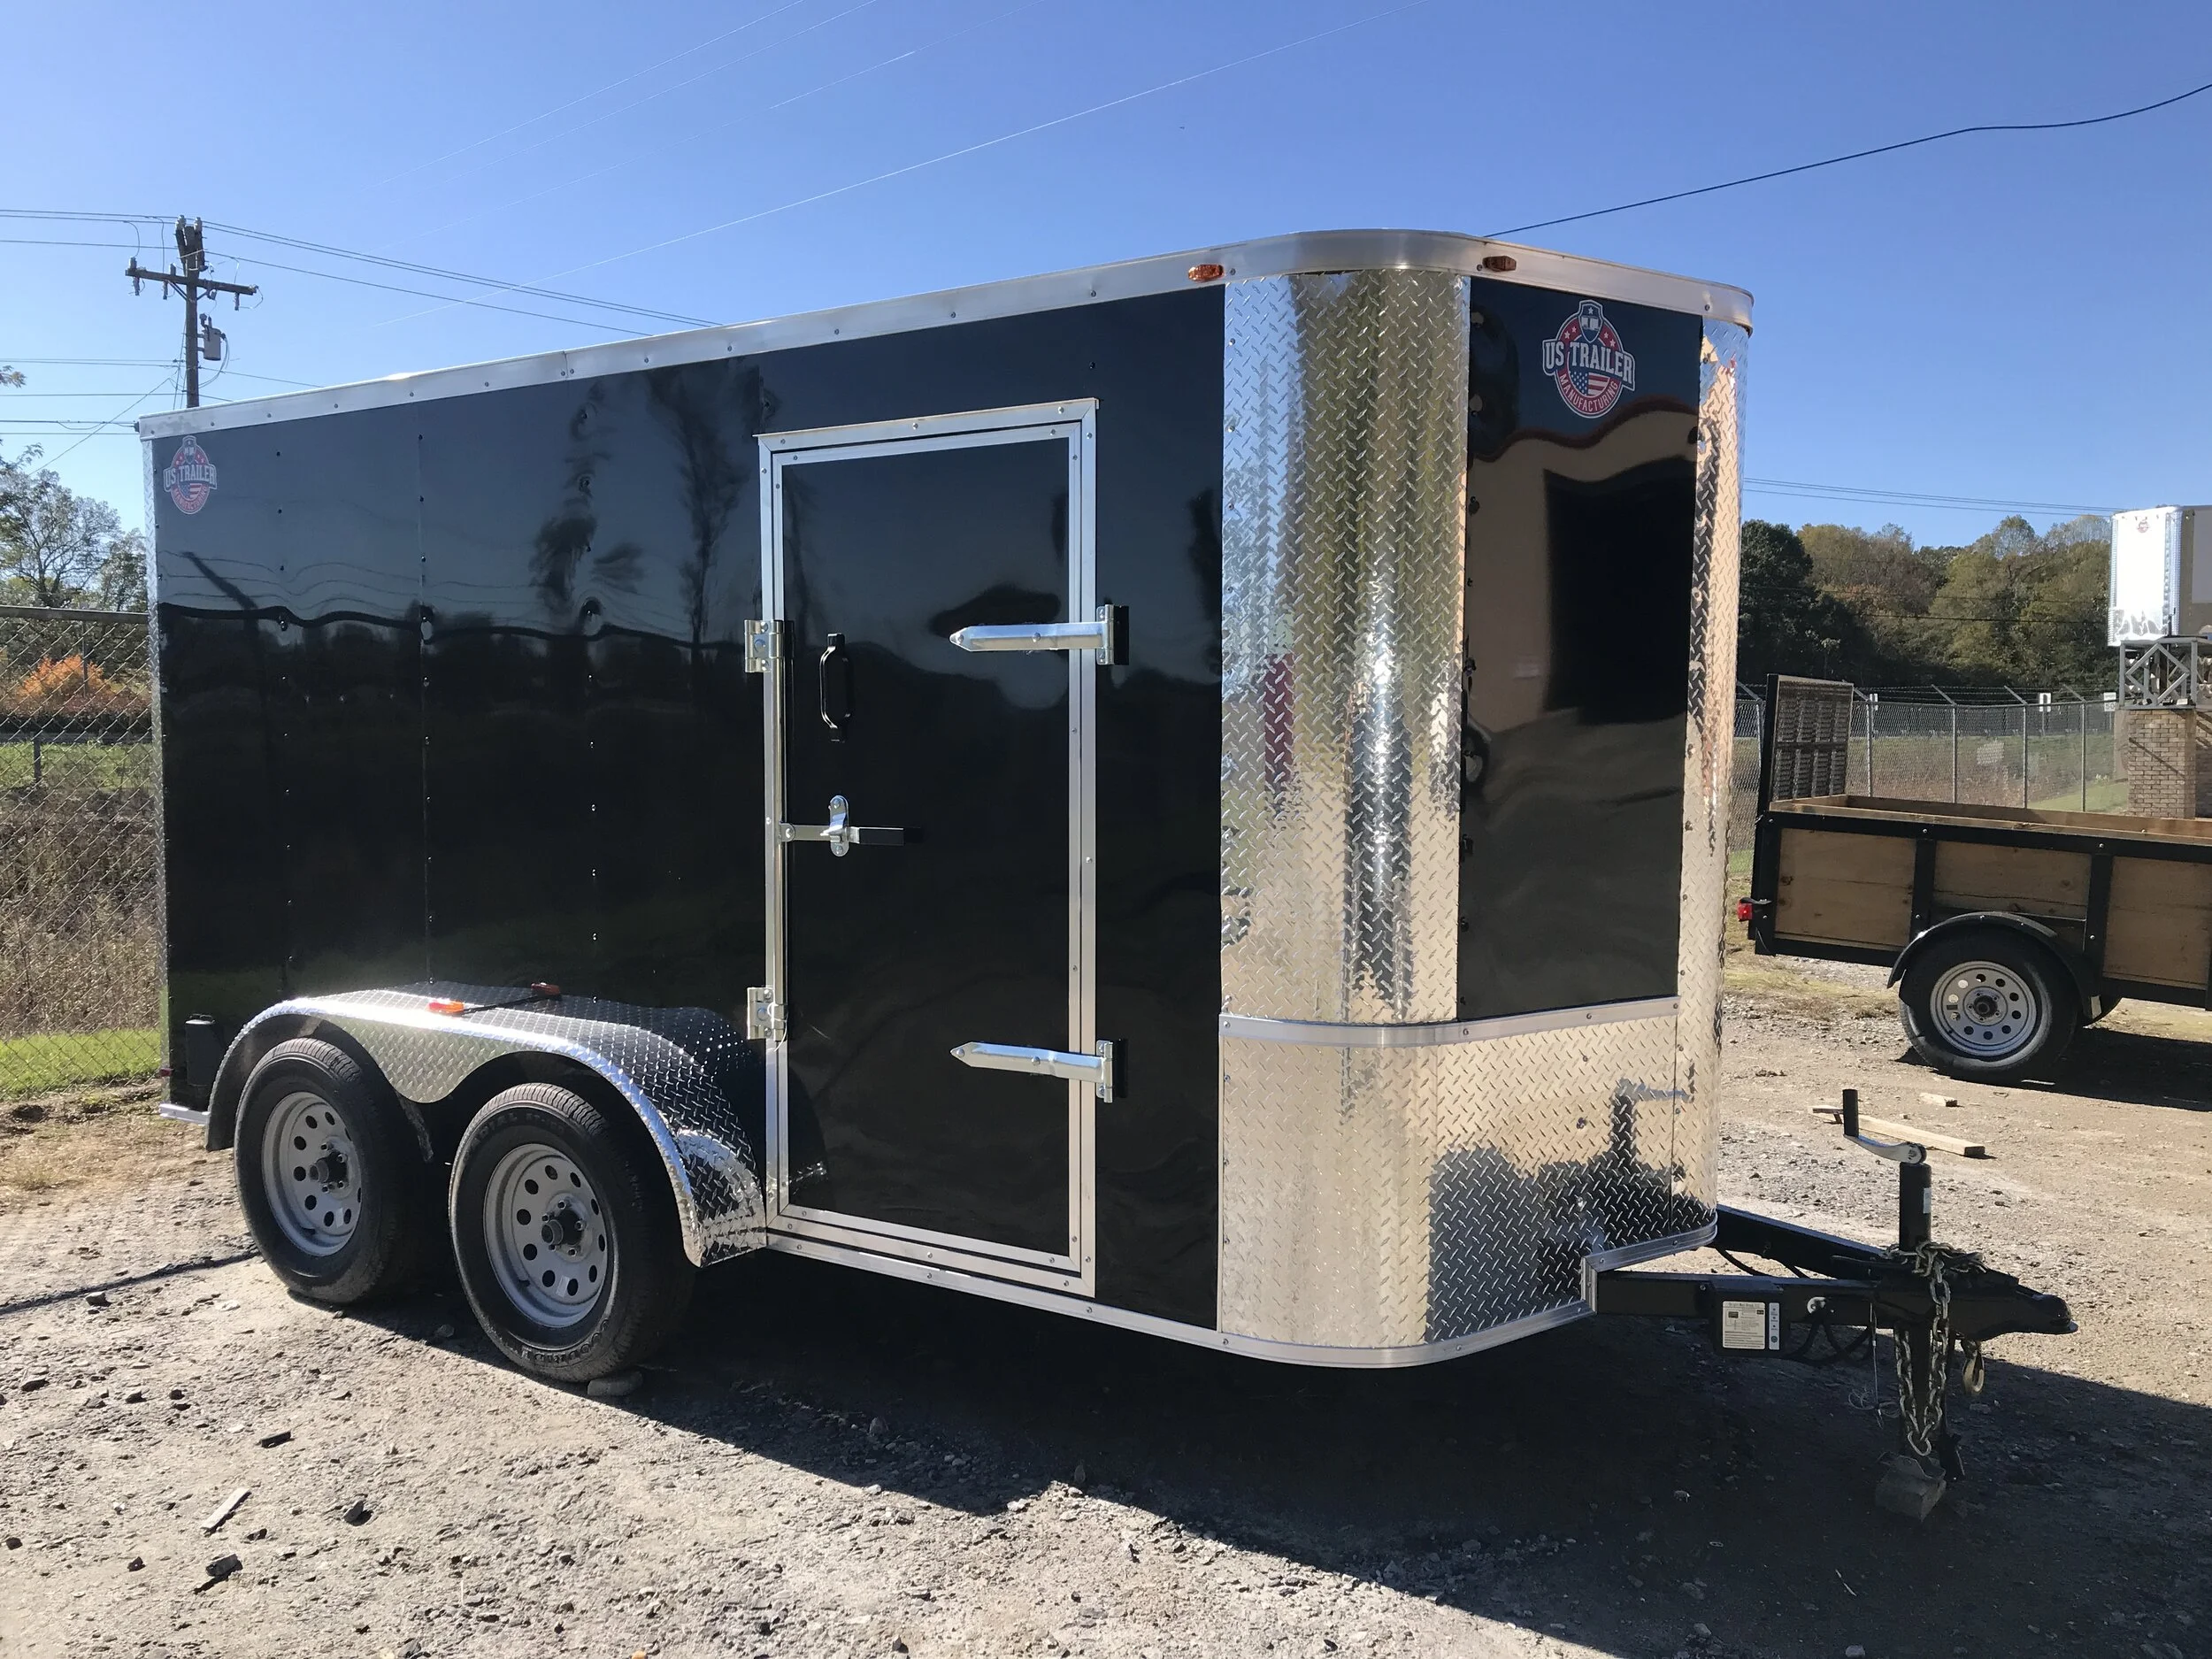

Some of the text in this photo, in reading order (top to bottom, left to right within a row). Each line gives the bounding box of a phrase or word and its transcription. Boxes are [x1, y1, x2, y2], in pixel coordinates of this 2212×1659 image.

[1545, 341, 1632, 384] US TRAILER
[1559, 373, 1618, 411] MANUFACTURING
[165, 465, 215, 488] US TRAILER
